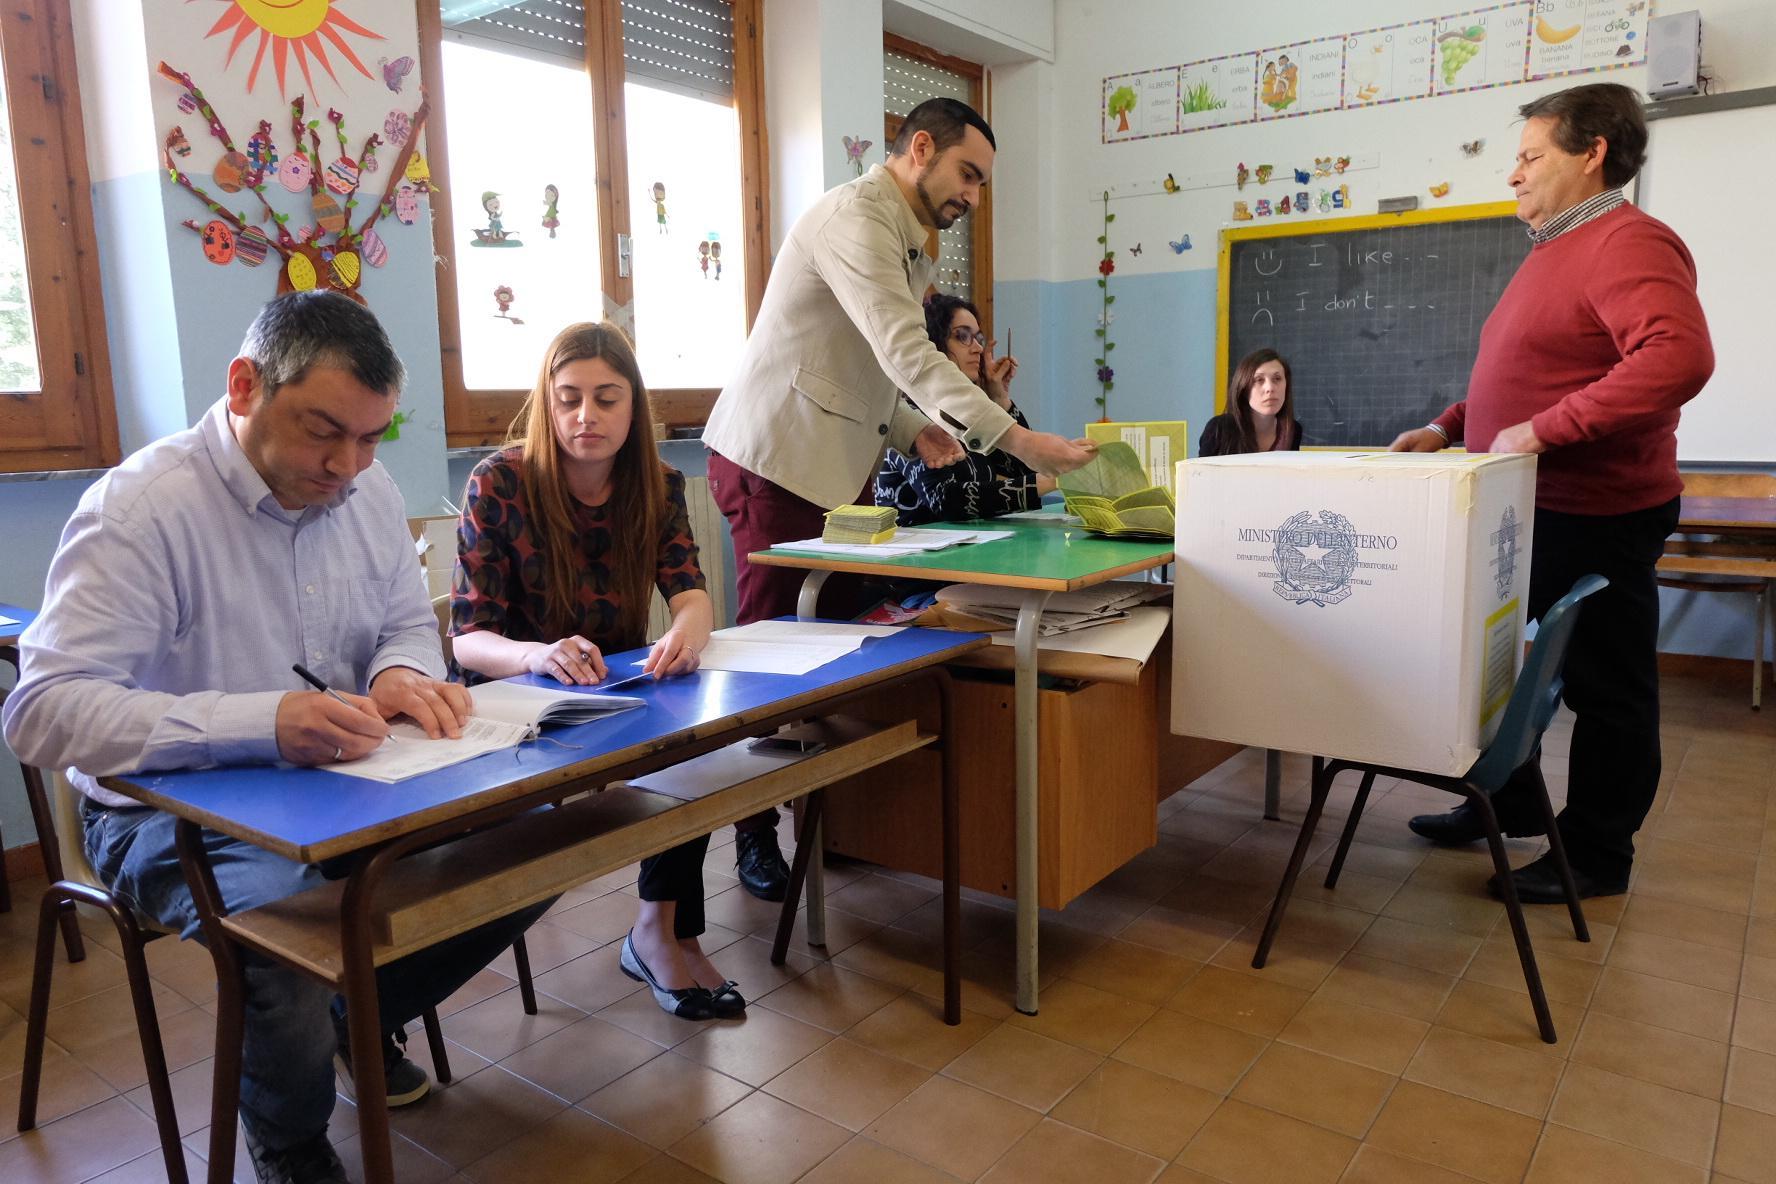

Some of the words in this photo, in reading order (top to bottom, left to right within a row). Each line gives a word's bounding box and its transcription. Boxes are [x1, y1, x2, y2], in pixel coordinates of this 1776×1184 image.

[1438, 22, 1448, 34] U
[1348, 38, 1358, 49] O
[1182, 69, 1189, 79] E
[1107, 82, 1114, 91] A
[1309, 243, 1326, 267] I
[1348, 242, 1393, 266] like
[1296, 291, 1310, 311] I
[1324, 289, 1376, 311] don't
[1236, 553, 1276, 562] DIPARTIMENT
